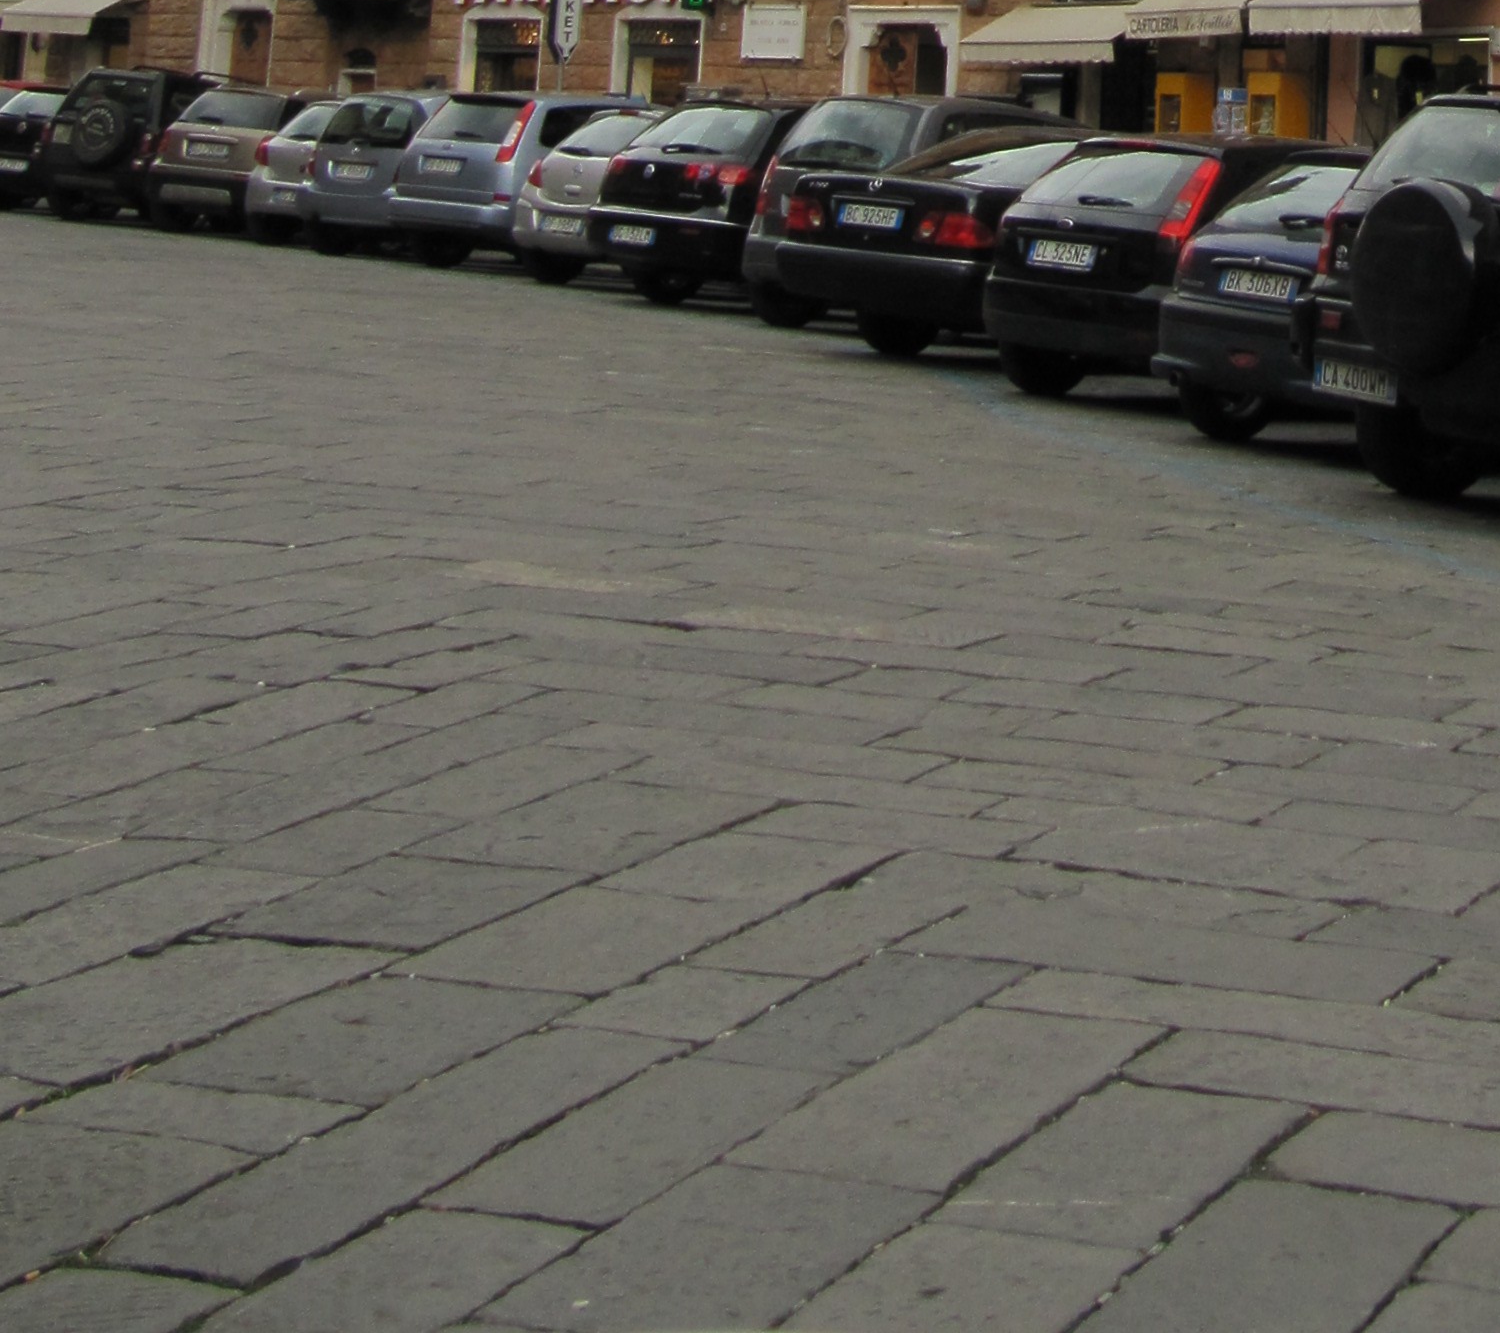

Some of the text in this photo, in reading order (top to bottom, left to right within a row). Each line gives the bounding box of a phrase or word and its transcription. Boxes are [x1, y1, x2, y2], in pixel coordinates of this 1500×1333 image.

[1129, 17, 1179, 33] CARTOLERIA
[1035, 240, 1089, 264] CL 325NE
[1226, 270, 1241, 290] BK
